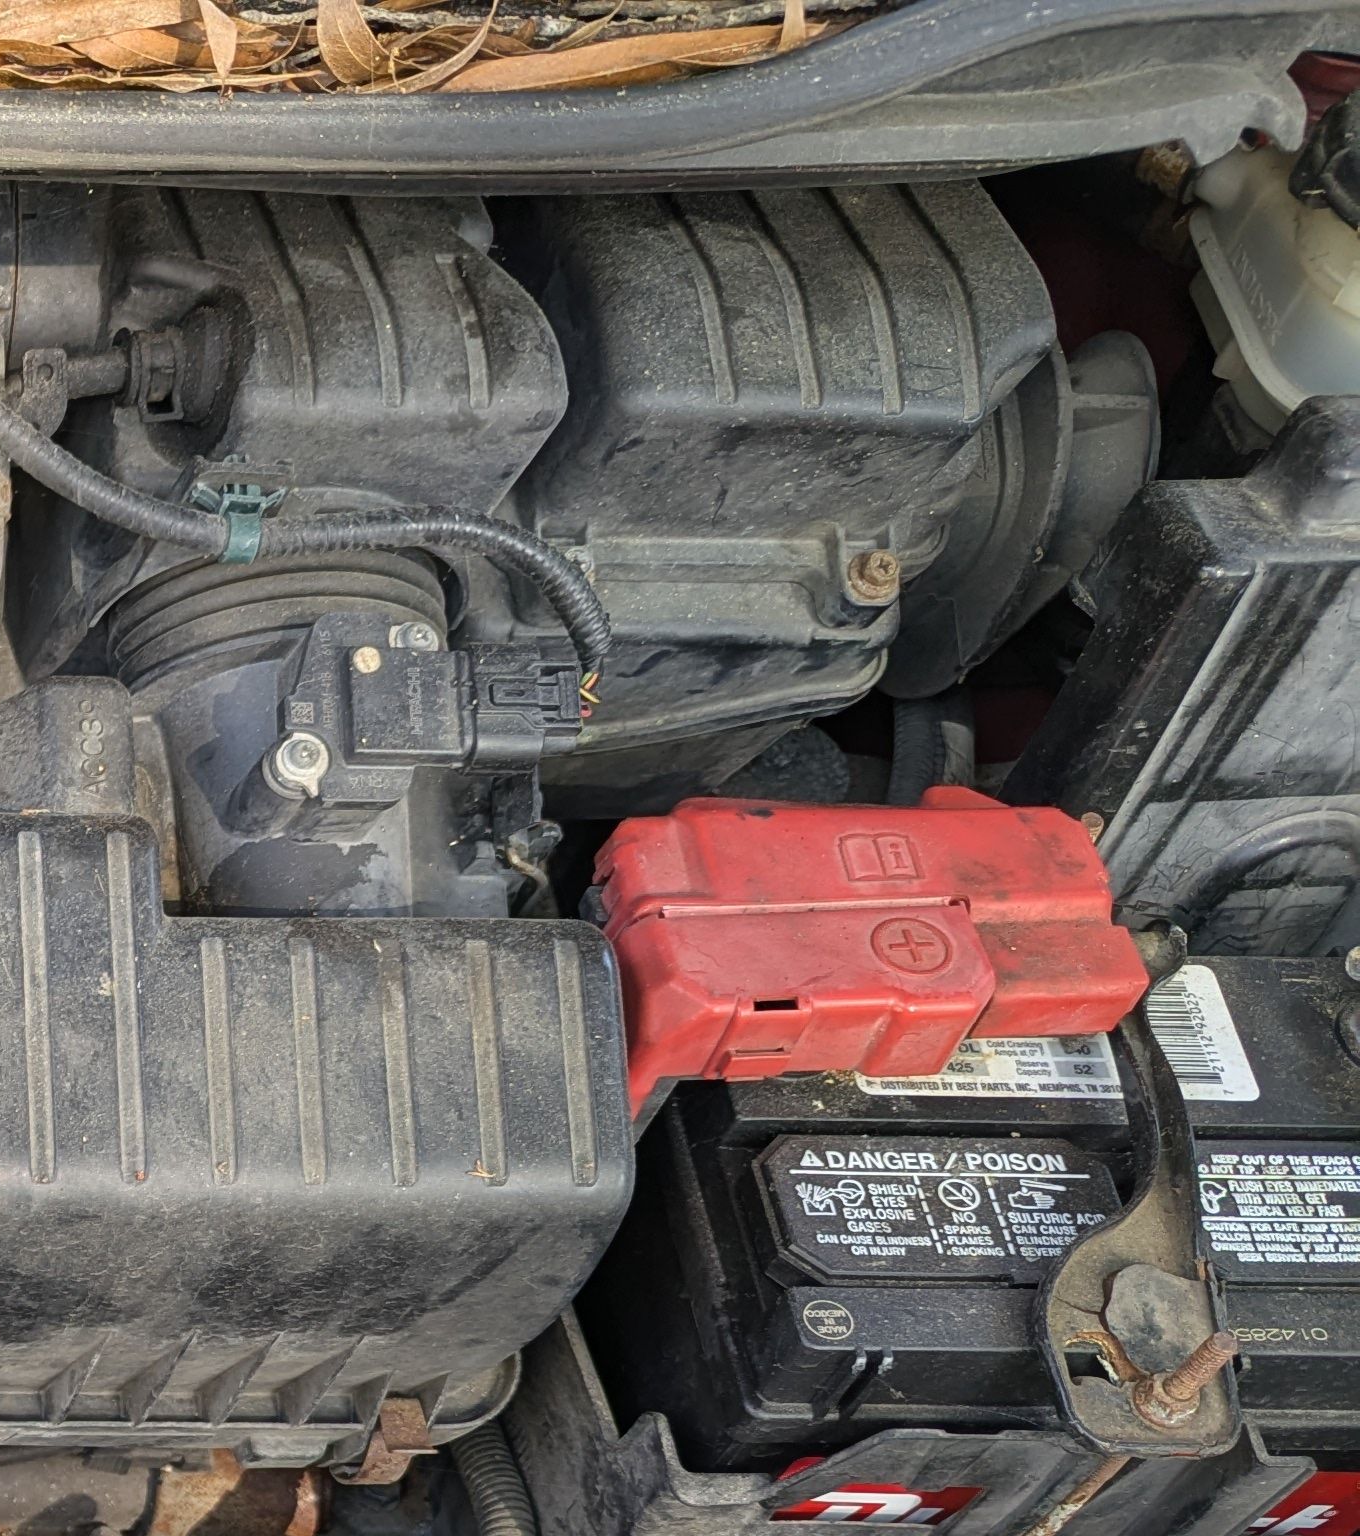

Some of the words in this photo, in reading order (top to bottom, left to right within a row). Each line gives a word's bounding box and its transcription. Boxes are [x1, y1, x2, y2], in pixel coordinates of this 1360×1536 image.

[407, 667, 424, 736] HITACHI
[1184, 992, 1208, 1034] 92025
[986, 1041, 1005, 1049] Cold
[1007, 1040, 1043, 1049] Cranking
[994, 1049, 1019, 1057] Amps
[1200, 1035, 1225, 1072] 21112
[947, 1062, 975, 1073] 425
[1016, 1060, 1049, 1068] Reserve
[1074, 1064, 1094, 1075] 52
[1016, 1067, 1052, 1077] Capacity
[880, 1080, 939, 1091] DISTRIBUTED
[941, 1081, 953, 1091] BY
[955, 1081, 978, 1091] BEST
[980, 1082, 1014, 1093] PARTS,
[1039, 1083, 1084, 1094] MEMPHIS,
[1087, 1083, 1099, 1093] TN
[825, 1151, 938, 1170] DANGER
[944, 1152, 957, 1171] /
[964, 1153, 1068, 1172] POISON
[1211, 1154, 1239, 1165] KEEP
[1242, 1155, 1265, 1165] OUT
[1269, 1155, 1285, 1165] OF
[1286, 1155, 1310, 1165] THE
[1312, 1155, 1351, 1166] REACH
[1212, 1164, 1234, 1174] NOT
[1261, 1166, 1289, 1175] KEEP
[1292, 1166, 1321, 1175] VENT
[1324, 1166, 1355, 1175] CAPS
[867, 1183, 917, 1196] SHIELD
[1227, 1180, 1263, 1192] FLUSH
[1265, 1180, 1293, 1192] EYES
[872, 1196, 907, 1208] EYES
[1232, 1193, 1262, 1204] WITH
[1305, 1193, 1328, 1204] GET
[843, 1208, 917, 1221] EXPLOSIVE
[1237, 1205, 1286, 1217] MEDICAL
[1286, 1205, 1316, 1217] HELP
[1317, 1205, 1345, 1217] FAST
[952, 1211, 977, 1224] NO
[1007, 1212, 1073, 1225] SULFURIC
[847, 1221, 892, 1233] GASES
[944, 1225, 991, 1235] SPARKS
[1012, 1225, 1037, 1235] CAN
[1040, 1225, 1078, 1236] CAUSE
[1250, 1223, 1272, 1232] FOR
[1273, 1223, 1300, 1232] SAFE
[1301, 1223, 1328, 1232] JUMP
[817, 1234, 838, 1244] CAN
[840, 1234, 873, 1245] CAUSE
[875, 1235, 931, 1246] BLINDNESS
[946, 1236, 994, 1246] FLAMES
[1210, 1232, 1252, 1242] FOLLOW
[1253, 1233, 1324, 1242] INSTRUCTIONS
[1326, 1234, 1339, 1242] IN
[851, 1245, 868, 1255] OR
[870, 1246, 906, 1256] INJURY
[952, 1246, 1006, 1257] SMOKING
[1211, 1242, 1255, 1251] OWNERS
[1313, 1244, 1336, 1252] NOT
[1237, 1253, 1265, 1262] SEEK
[1265, 1253, 1308, 1262] SERVICE
[806, 1309, 847, 1318] MEXICO
[823, 1317, 836, 1325] IN
[817, 1325, 848, 1333] MADE
